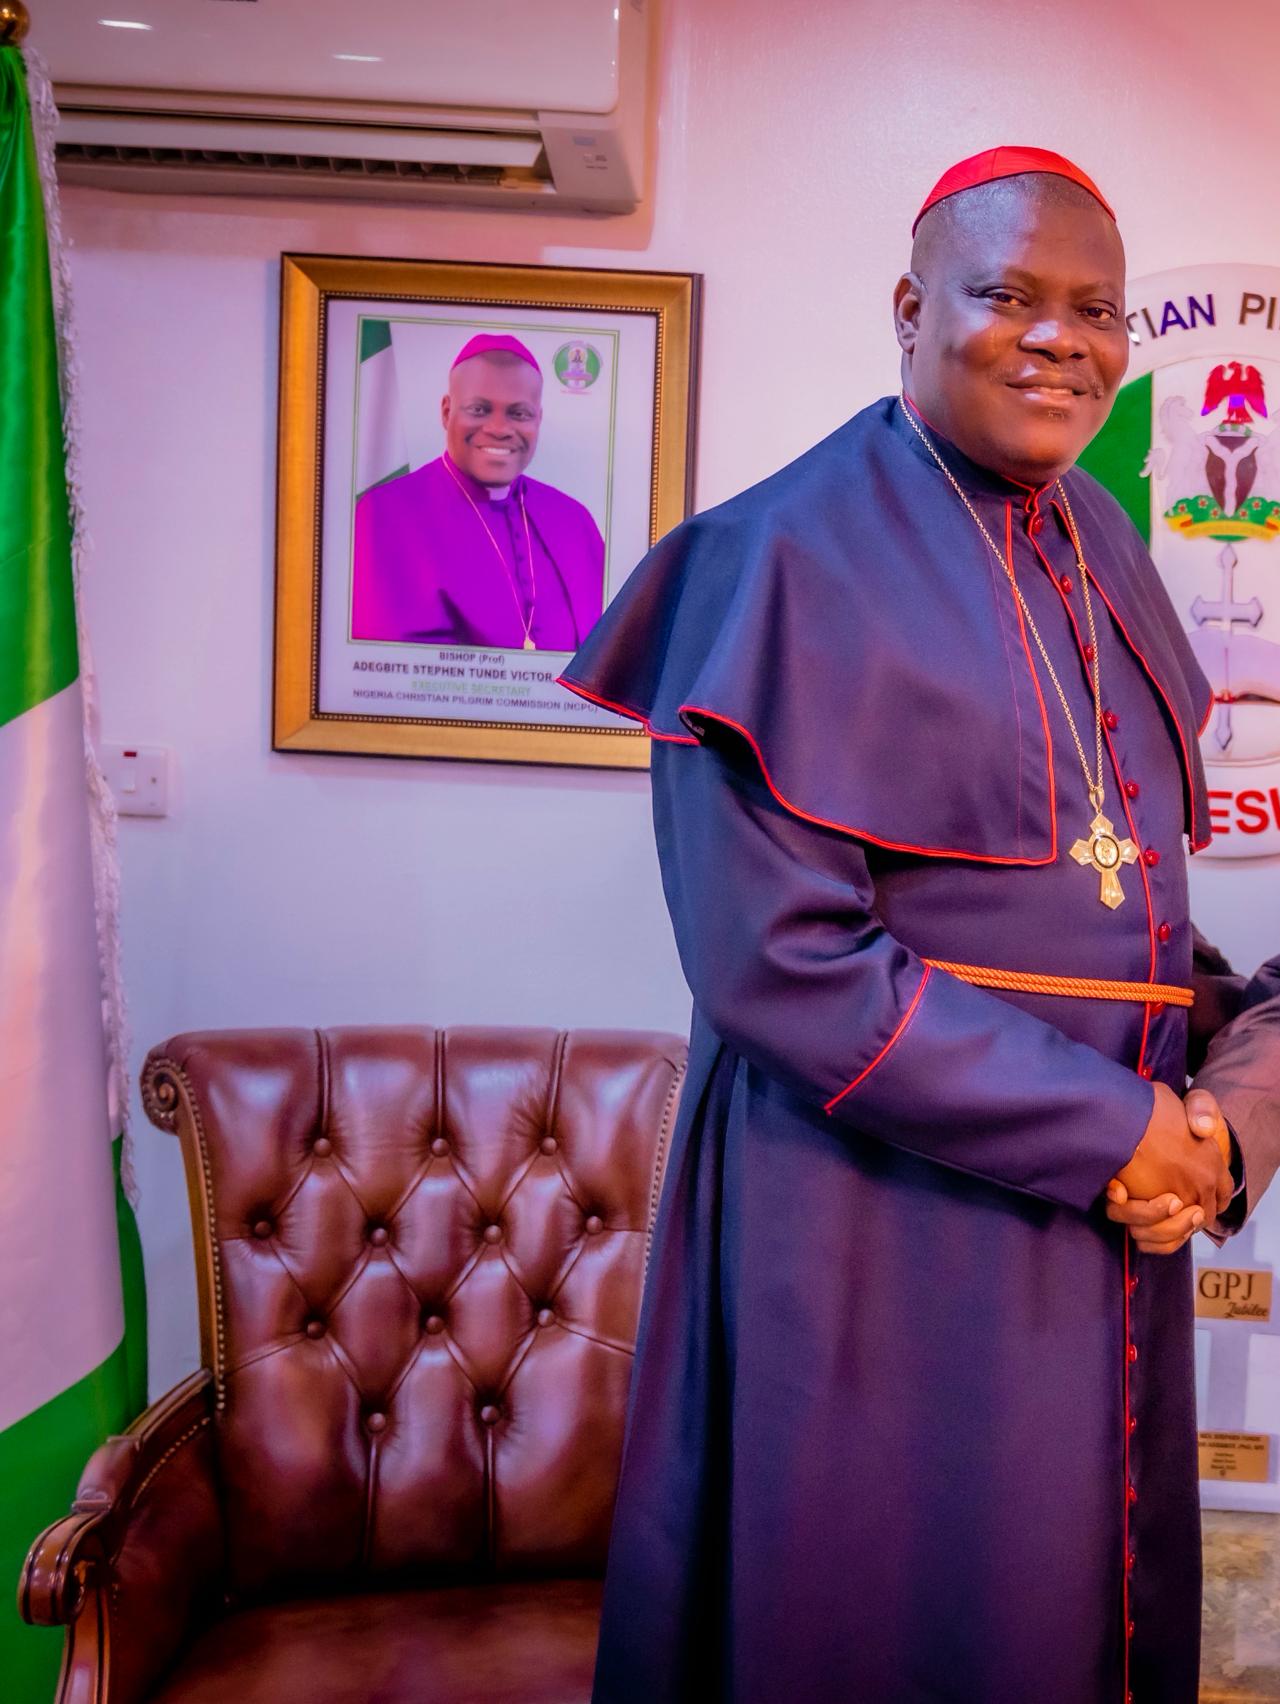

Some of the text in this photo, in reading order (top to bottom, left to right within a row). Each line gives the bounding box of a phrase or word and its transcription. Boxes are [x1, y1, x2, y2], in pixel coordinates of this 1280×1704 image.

[439, 651, 505, 666] BISHOP (Prof)
[352, 661, 409, 674] ADEGBITE
[413, 664, 465, 678] STEPHEN
[469, 667, 507, 680] TUNDE
[352, 689, 393, 699] NIGERIA
[396, 691, 449, 703] CHRISTIAN
[452, 695, 493, 705] PILGRIM
[496, 698, 561, 710] COMMISSION
[1199, 1270, 1255, 1301] GPJ
